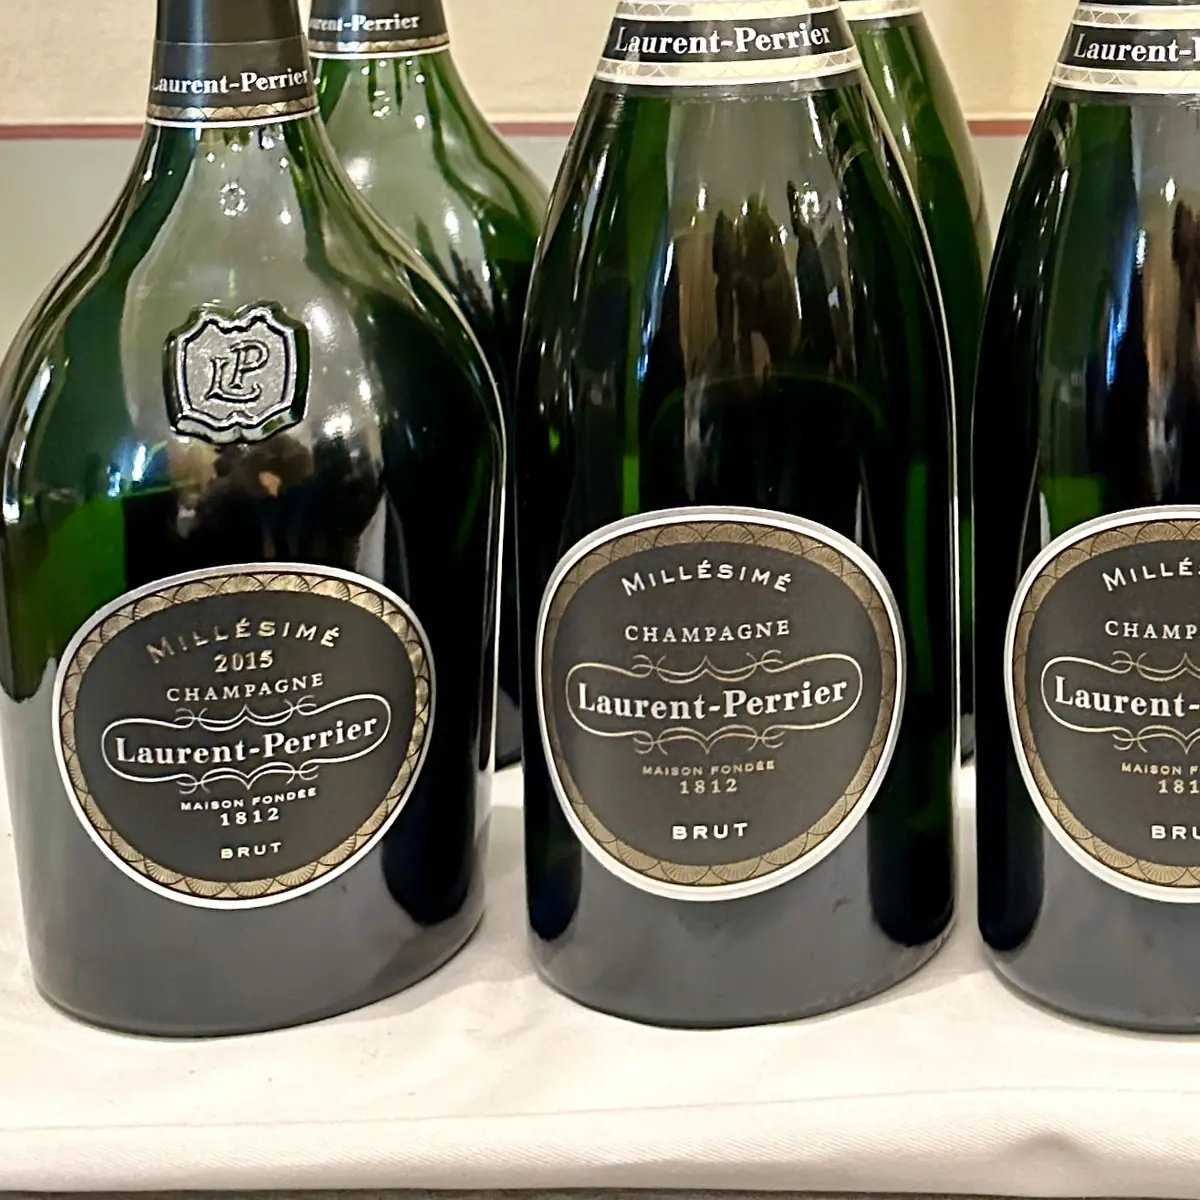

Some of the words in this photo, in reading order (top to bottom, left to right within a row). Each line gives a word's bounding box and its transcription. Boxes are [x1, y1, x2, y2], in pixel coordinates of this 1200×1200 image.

[613, 22, 832, 56] Laurent-Perrier
[203, 339, 270, 404] LP
[621, 558, 793, 597] MILLÉSIMÉ
[144, 616, 341, 665] MILLÉSIMÉ
[624, 619, 791, 643] CHAMPAGNE
[214, 649, 274, 674] 2015
[166, 672, 325, 702] CHAMPAGNE
[577, 678, 848, 720] Laurent-Perrier
[115, 713, 379, 765] Laurent-Perrier
[642, 764, 704, 777] MAISON
[710, 760, 776, 774] FONDÉE
[1120, 762, 1182, 776] MAISON
[180, 797, 244, 812] MAISON
[252, 786, 318, 807] FONDÉE
[679, 778, 738, 795] 1812
[219, 807, 280, 827] 1812
[671, 822, 749, 841] BRUT
[220, 841, 283, 860] BRUT
